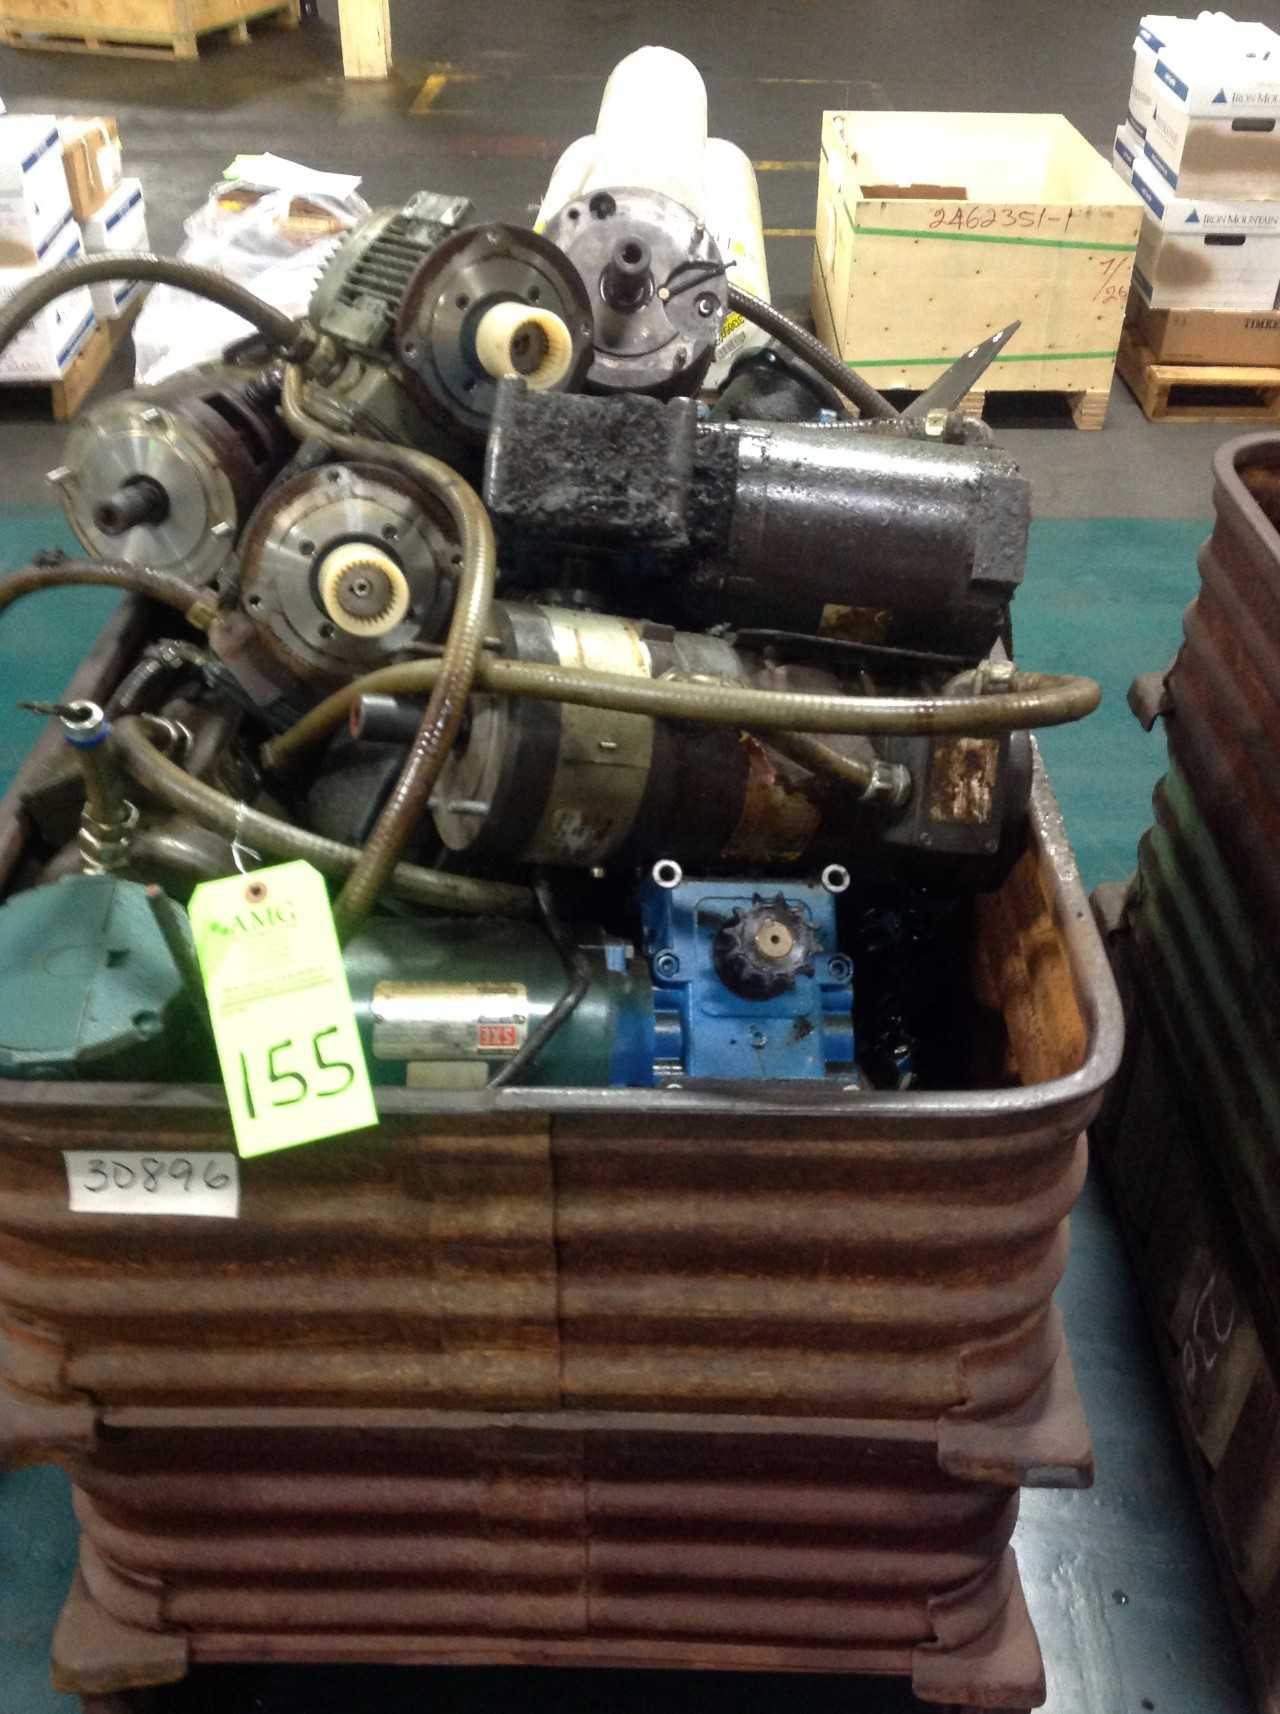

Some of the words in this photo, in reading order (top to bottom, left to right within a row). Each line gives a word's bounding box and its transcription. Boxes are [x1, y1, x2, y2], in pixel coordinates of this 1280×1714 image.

[1203, 214, 1226, 225] IRON
[240, 1025, 355, 1120] 155
[84, 1157, 230, 1193] 30896
